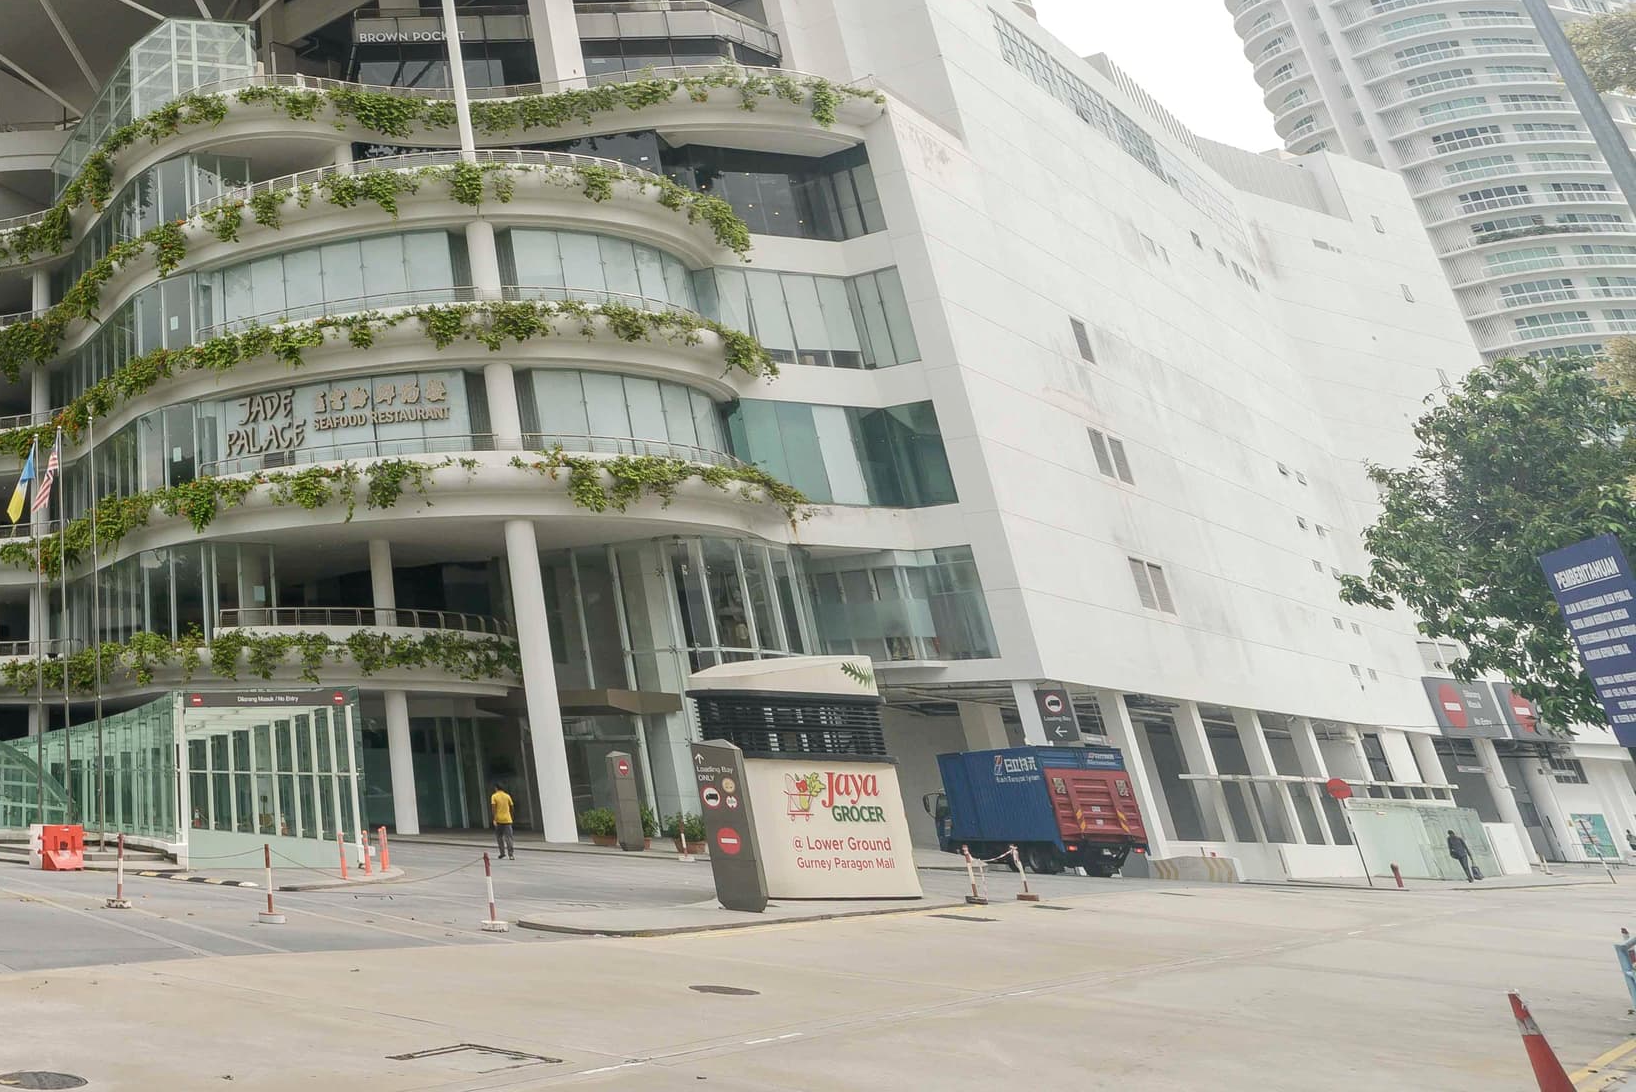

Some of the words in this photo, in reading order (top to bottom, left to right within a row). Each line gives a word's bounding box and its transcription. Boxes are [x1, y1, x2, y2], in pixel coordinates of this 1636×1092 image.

[359, 32, 409, 43] BROWN
[412, 30, 465, 42] POCKT
[238, 389, 295, 426] JADE
[314, 414, 367, 432] SEAFOOD
[371, 406, 451, 425] RESTAURANT
[226, 418, 307, 459] PALACE
[696, 765, 721, 775] Loading
[698, 774, 715, 782] ONLY
[821, 771, 880, 808] Jaya
[832, 805, 886, 823] GROCER
[792, 835, 803, 852] @
[806, 835, 844, 851] Lower
[847, 836, 892, 851] Ground
[796, 856, 832, 871] Gurney
[834, 857, 874, 871] Paragon
[875, 857, 896, 869] Mall
